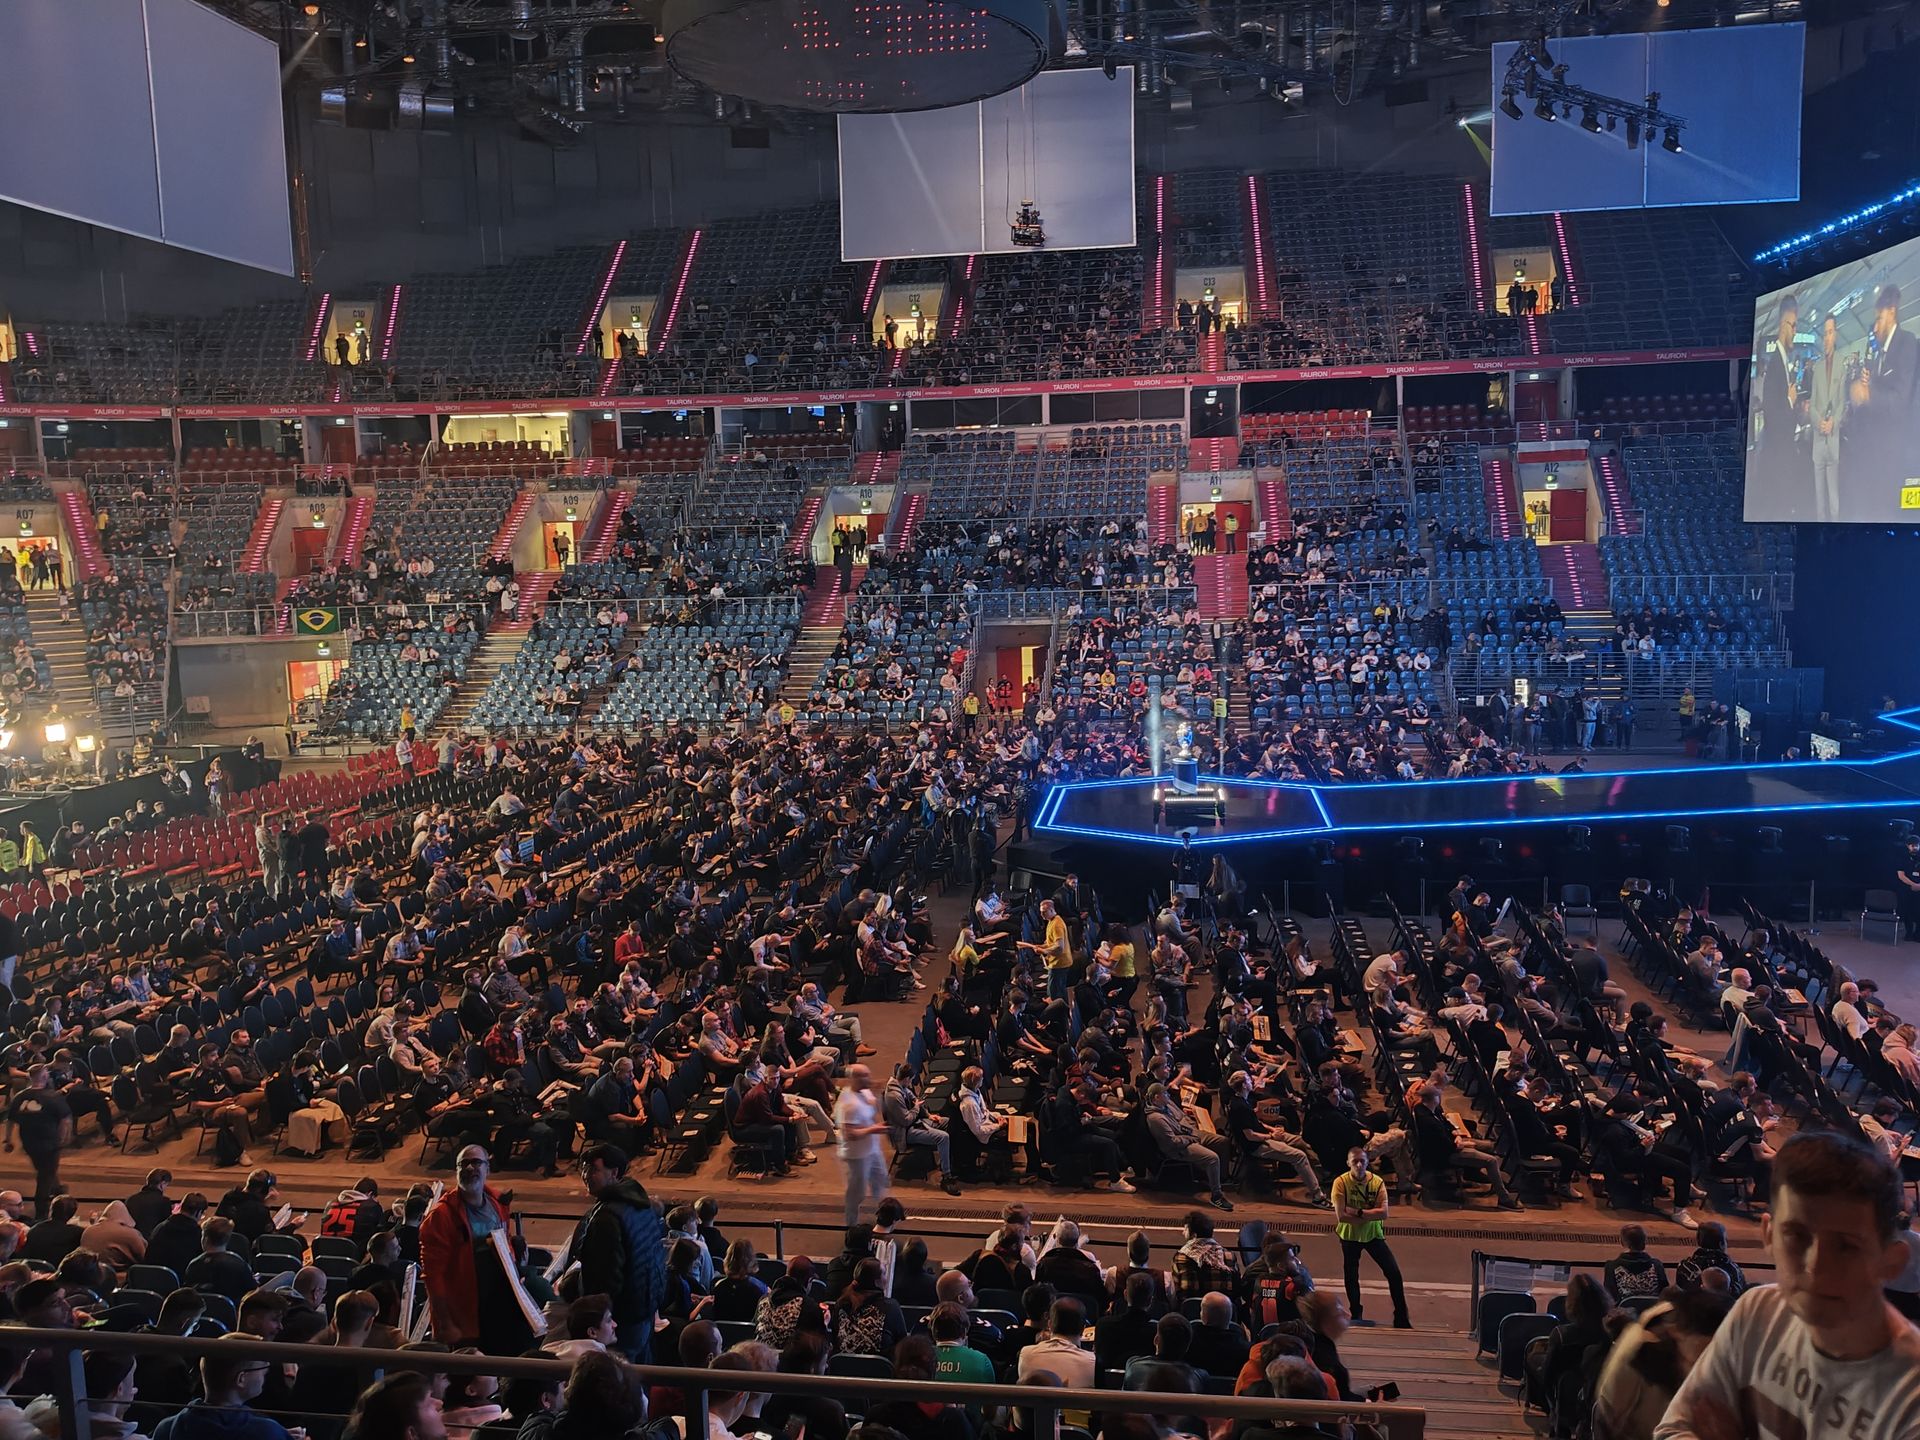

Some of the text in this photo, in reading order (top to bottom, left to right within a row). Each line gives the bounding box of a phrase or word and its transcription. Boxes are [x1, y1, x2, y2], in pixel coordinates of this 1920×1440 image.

[1513, 258, 1527, 268] C14
[1203, 277, 1216, 286] C13
[908, 294, 921, 302] C12
[352, 309, 366, 318] C10
[630, 305, 641, 314] C11
[1656, 352, 1687, 360] TAURON
[1563, 357, 1594, 365] TAURON
[1385, 366, 1415, 374] TAURON
[1472, 362, 1503, 370] TAURON
[819, 393, 845, 401] TAURON
[94, 408, 125, 416] TAURON
[185, 408, 214, 416] TAURON
[1543, 462, 1560, 473] A12
[1209, 475, 1222, 486] A11
[859, 488, 873, 498] A10
[563, 495, 579, 505] A09
[309, 503, 326, 513] A08
[16, 509, 34, 519] A07
[322, 1208, 356, 1236] 25
